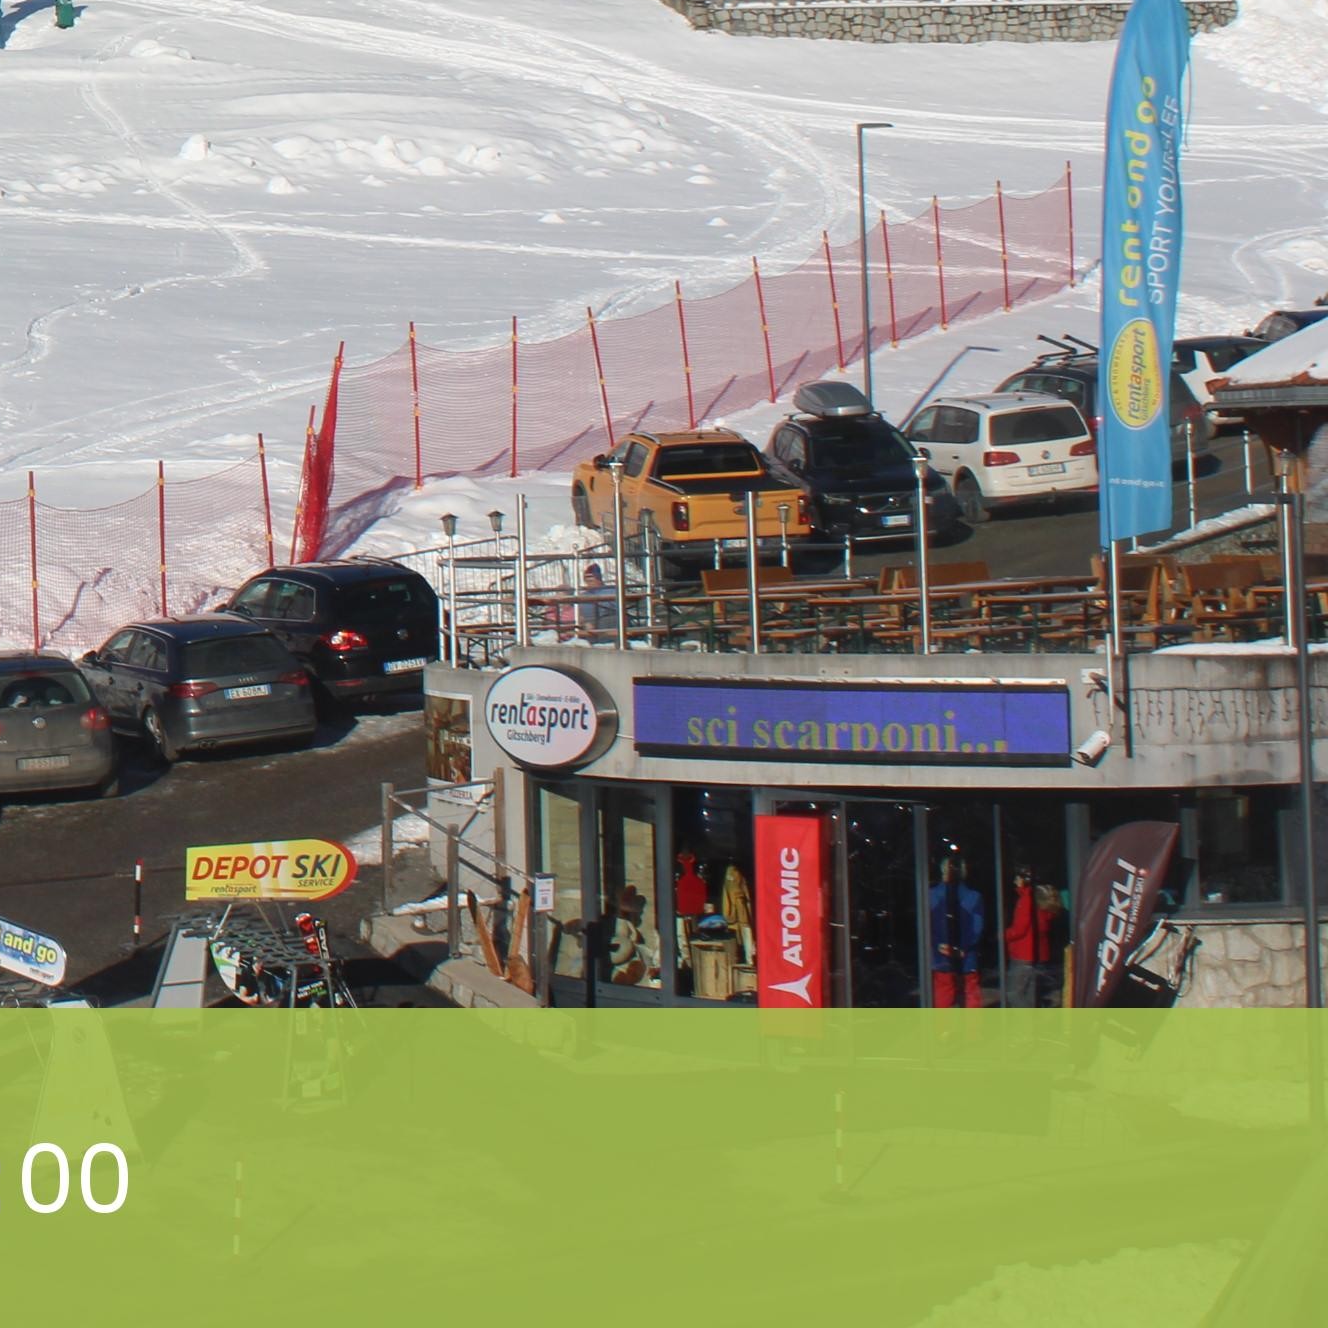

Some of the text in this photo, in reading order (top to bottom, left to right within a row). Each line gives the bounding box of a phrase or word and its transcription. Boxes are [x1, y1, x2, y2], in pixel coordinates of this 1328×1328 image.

[1124, 129, 1152, 208] and
[1119, 218, 1142, 306] rent
[1147, 220, 1173, 305] SPORT
[1128, 328, 1147, 420] rentasport
[490, 692, 590, 743] rentasport
[506, 729, 546, 745] Gitschberg
[687, 705, 738, 747] sci
[192, 854, 343, 880] DEPOT SKI
[297, 878, 336, 888] SERVICE
[780, 846, 804, 969] ATOMIC
[1129, 894, 1142, 924] SWISS
[4, 932, 34, 955] and
[35, 944, 58, 964] go
[1124, 923, 1136, 943] THE
